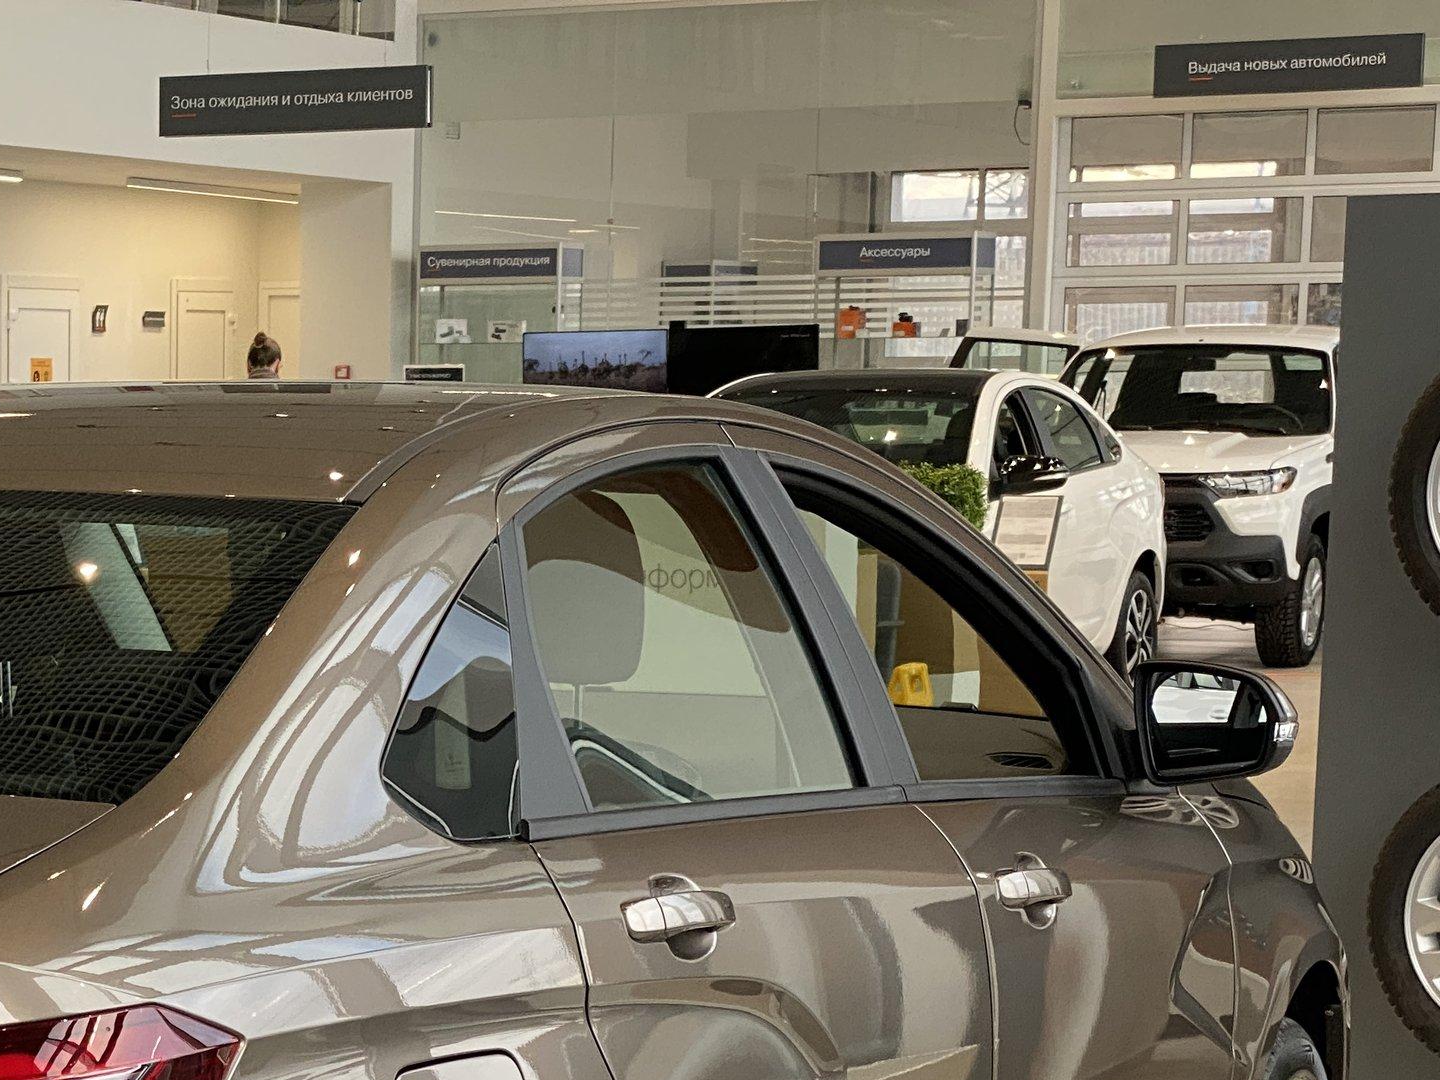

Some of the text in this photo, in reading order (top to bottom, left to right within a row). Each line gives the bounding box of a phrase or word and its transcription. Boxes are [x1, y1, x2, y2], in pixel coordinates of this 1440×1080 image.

[1188, 52, 1387, 75] Выдача новых автомобилей
[170, 88, 414, 110] Зона ожидания и отдыха клиентов
[859, 246, 931, 259] Аксессуары
[427, 256, 550, 269] Сувенирная продукция
